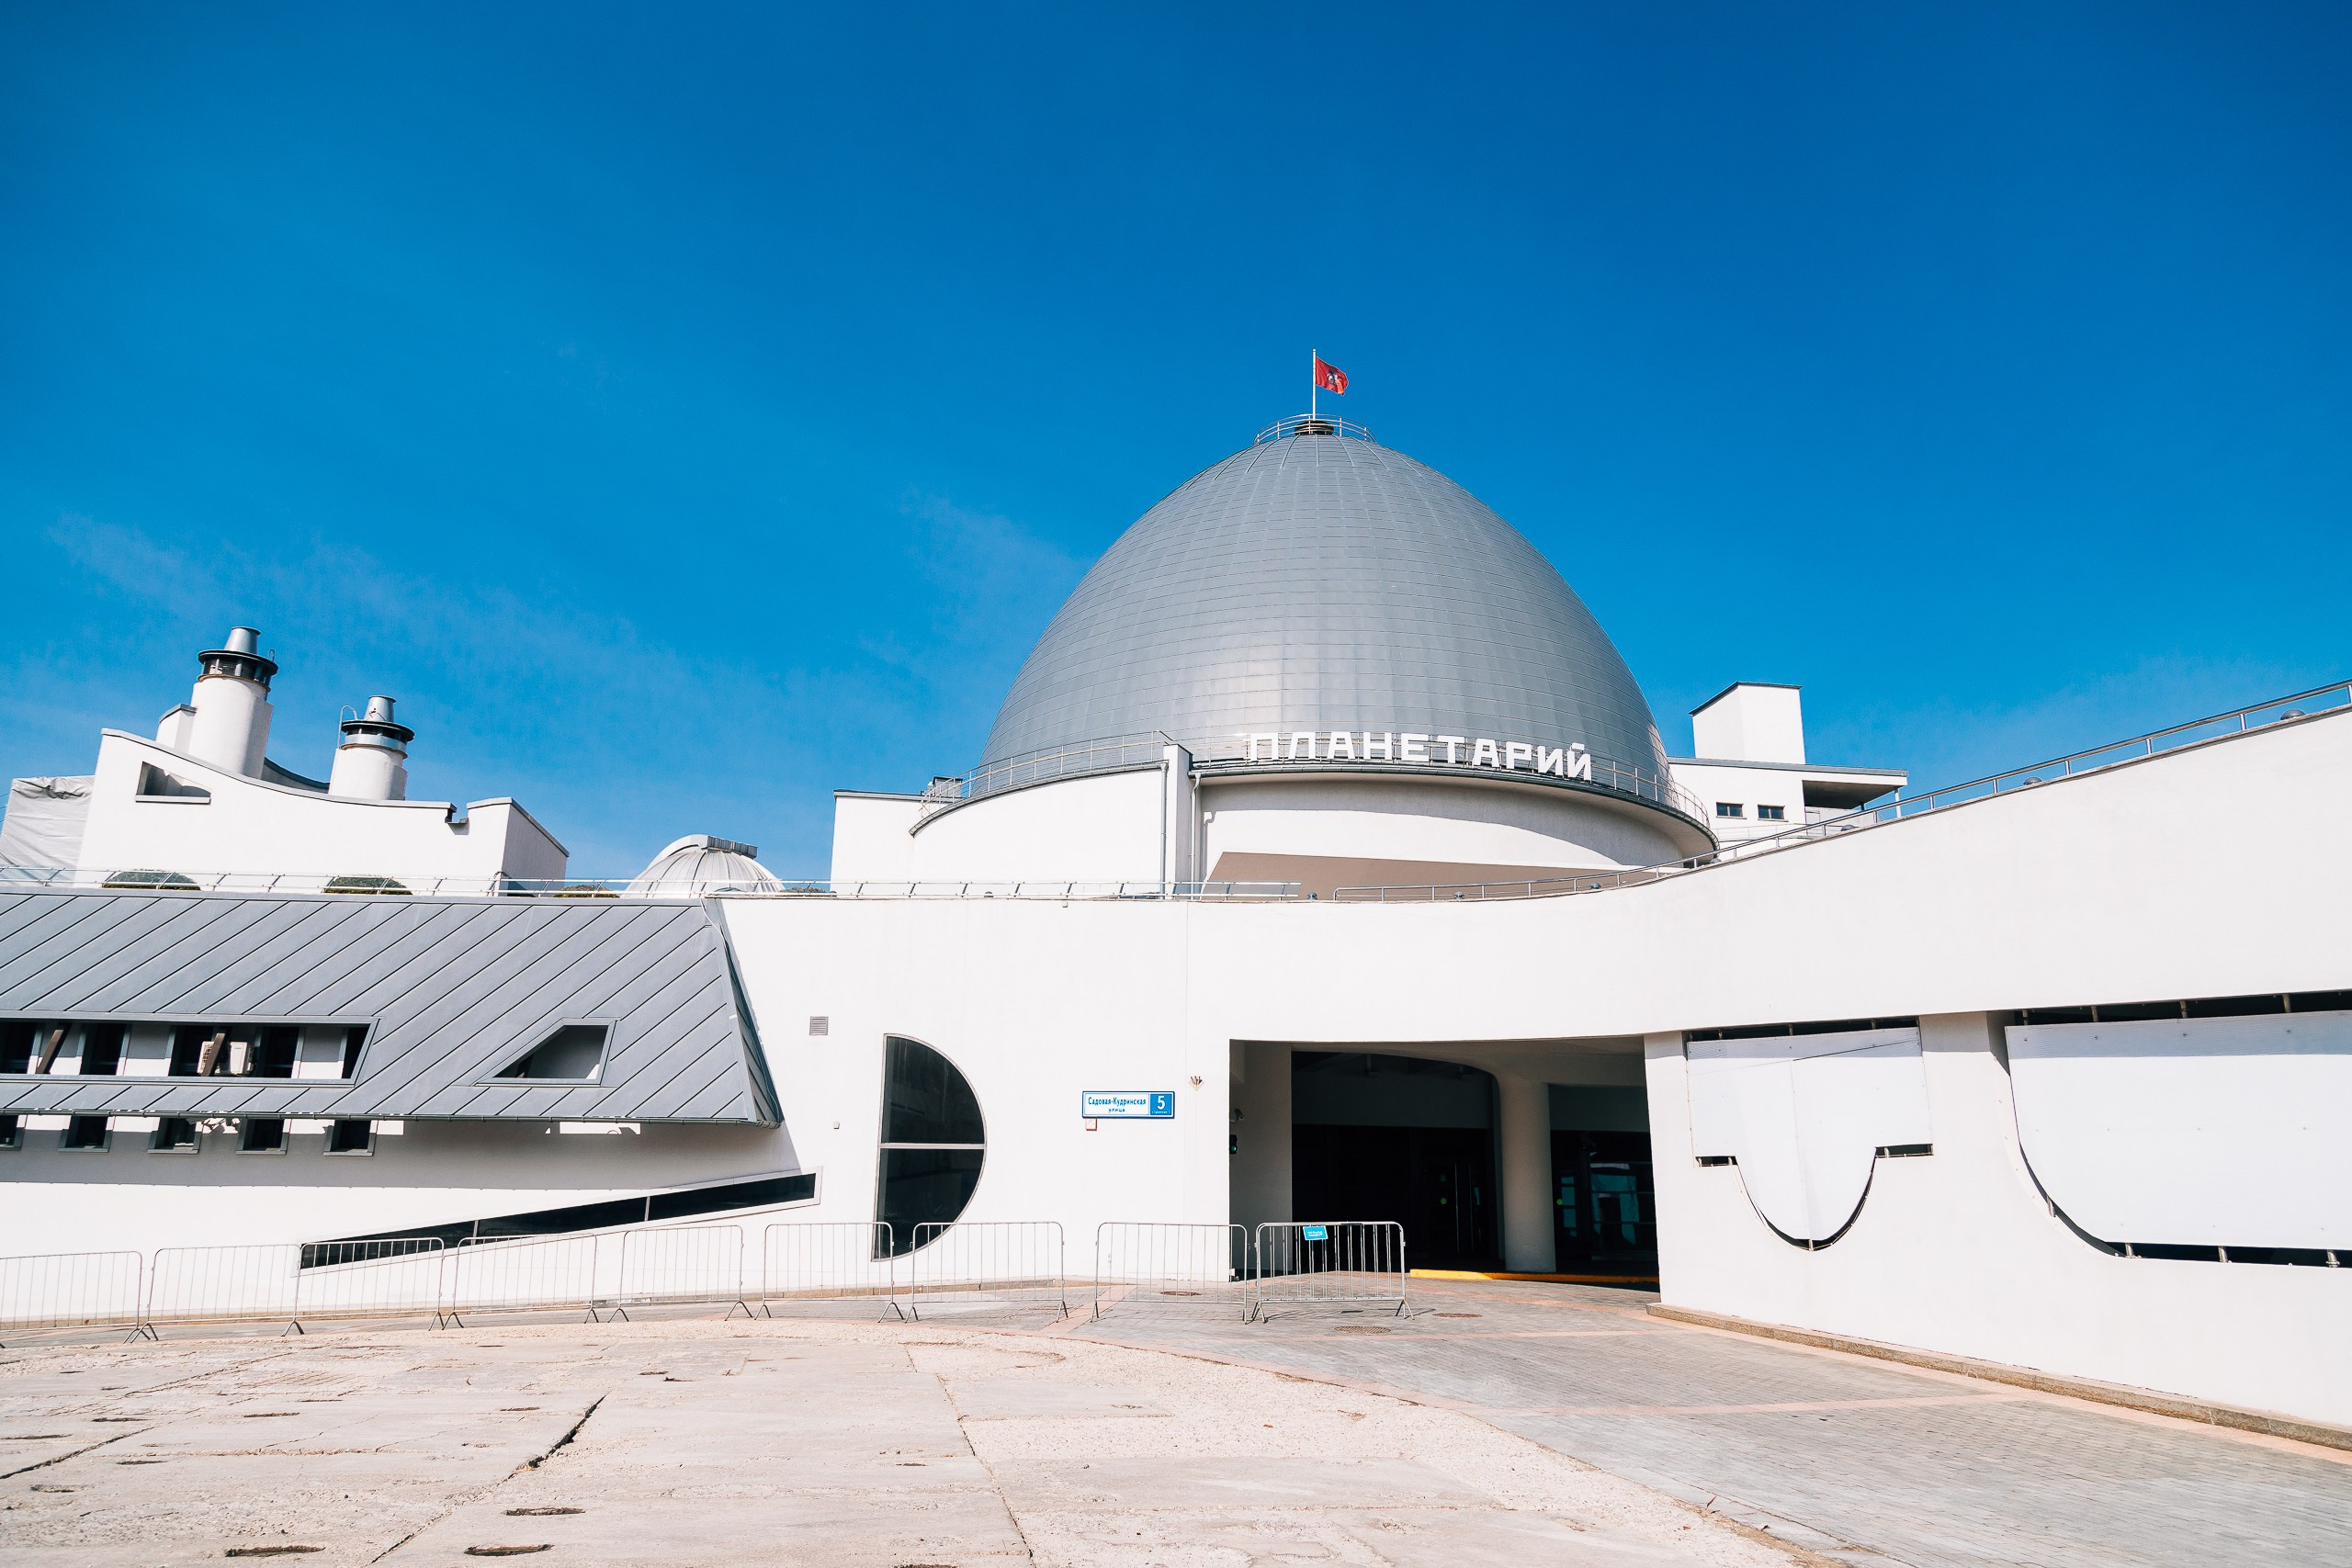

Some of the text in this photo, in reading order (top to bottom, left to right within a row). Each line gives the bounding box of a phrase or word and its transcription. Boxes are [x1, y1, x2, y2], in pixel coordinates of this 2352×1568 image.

[1250, 731, 1592, 782] ПЛАНЕТАРИЙ
[1088, 1097, 1147, 1107] Садовая-Кудринская
[1157, 1095, 1166, 1110] 5
